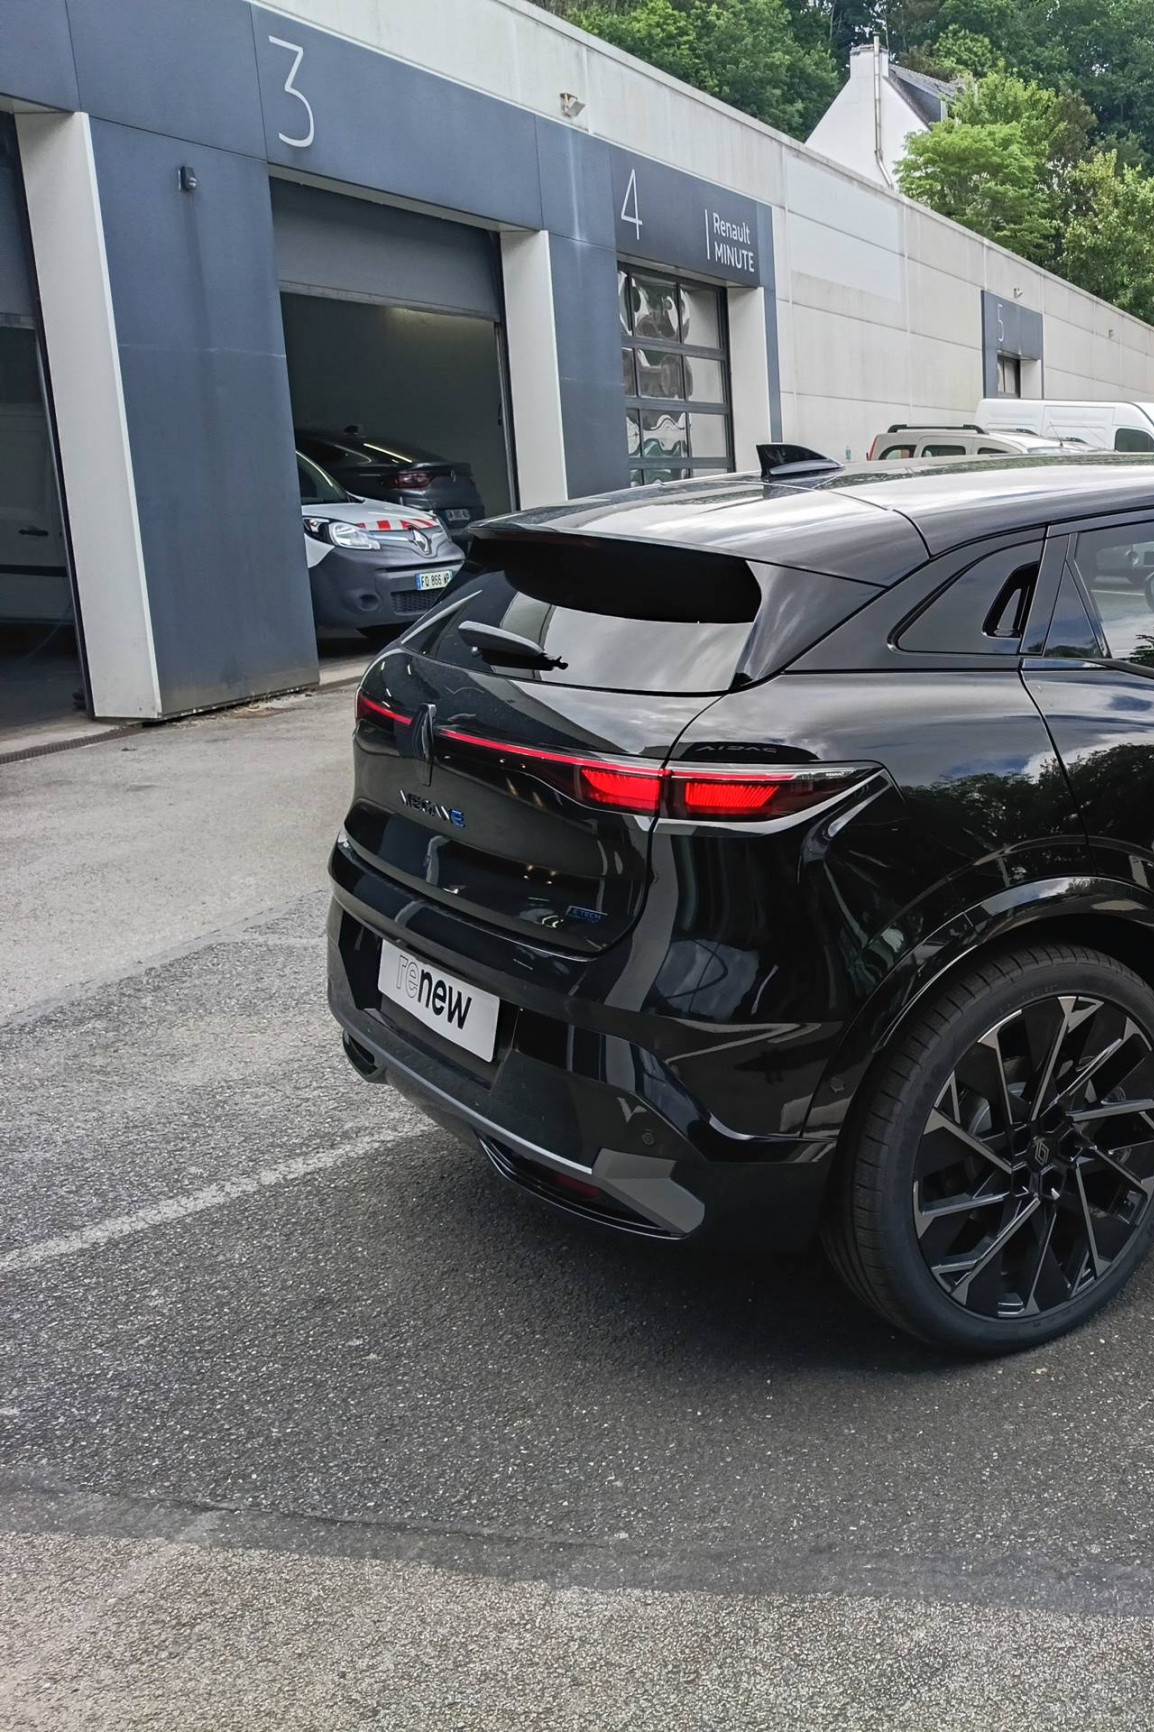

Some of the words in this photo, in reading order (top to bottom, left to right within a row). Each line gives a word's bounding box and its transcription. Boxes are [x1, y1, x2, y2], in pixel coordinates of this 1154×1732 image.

[268, 35, 315, 148] 3
[621, 168, 643, 241] 4
[712, 212, 751, 245] Renault
[714, 241, 755, 273] MINUTE
[396, 954, 472, 1030] renew
